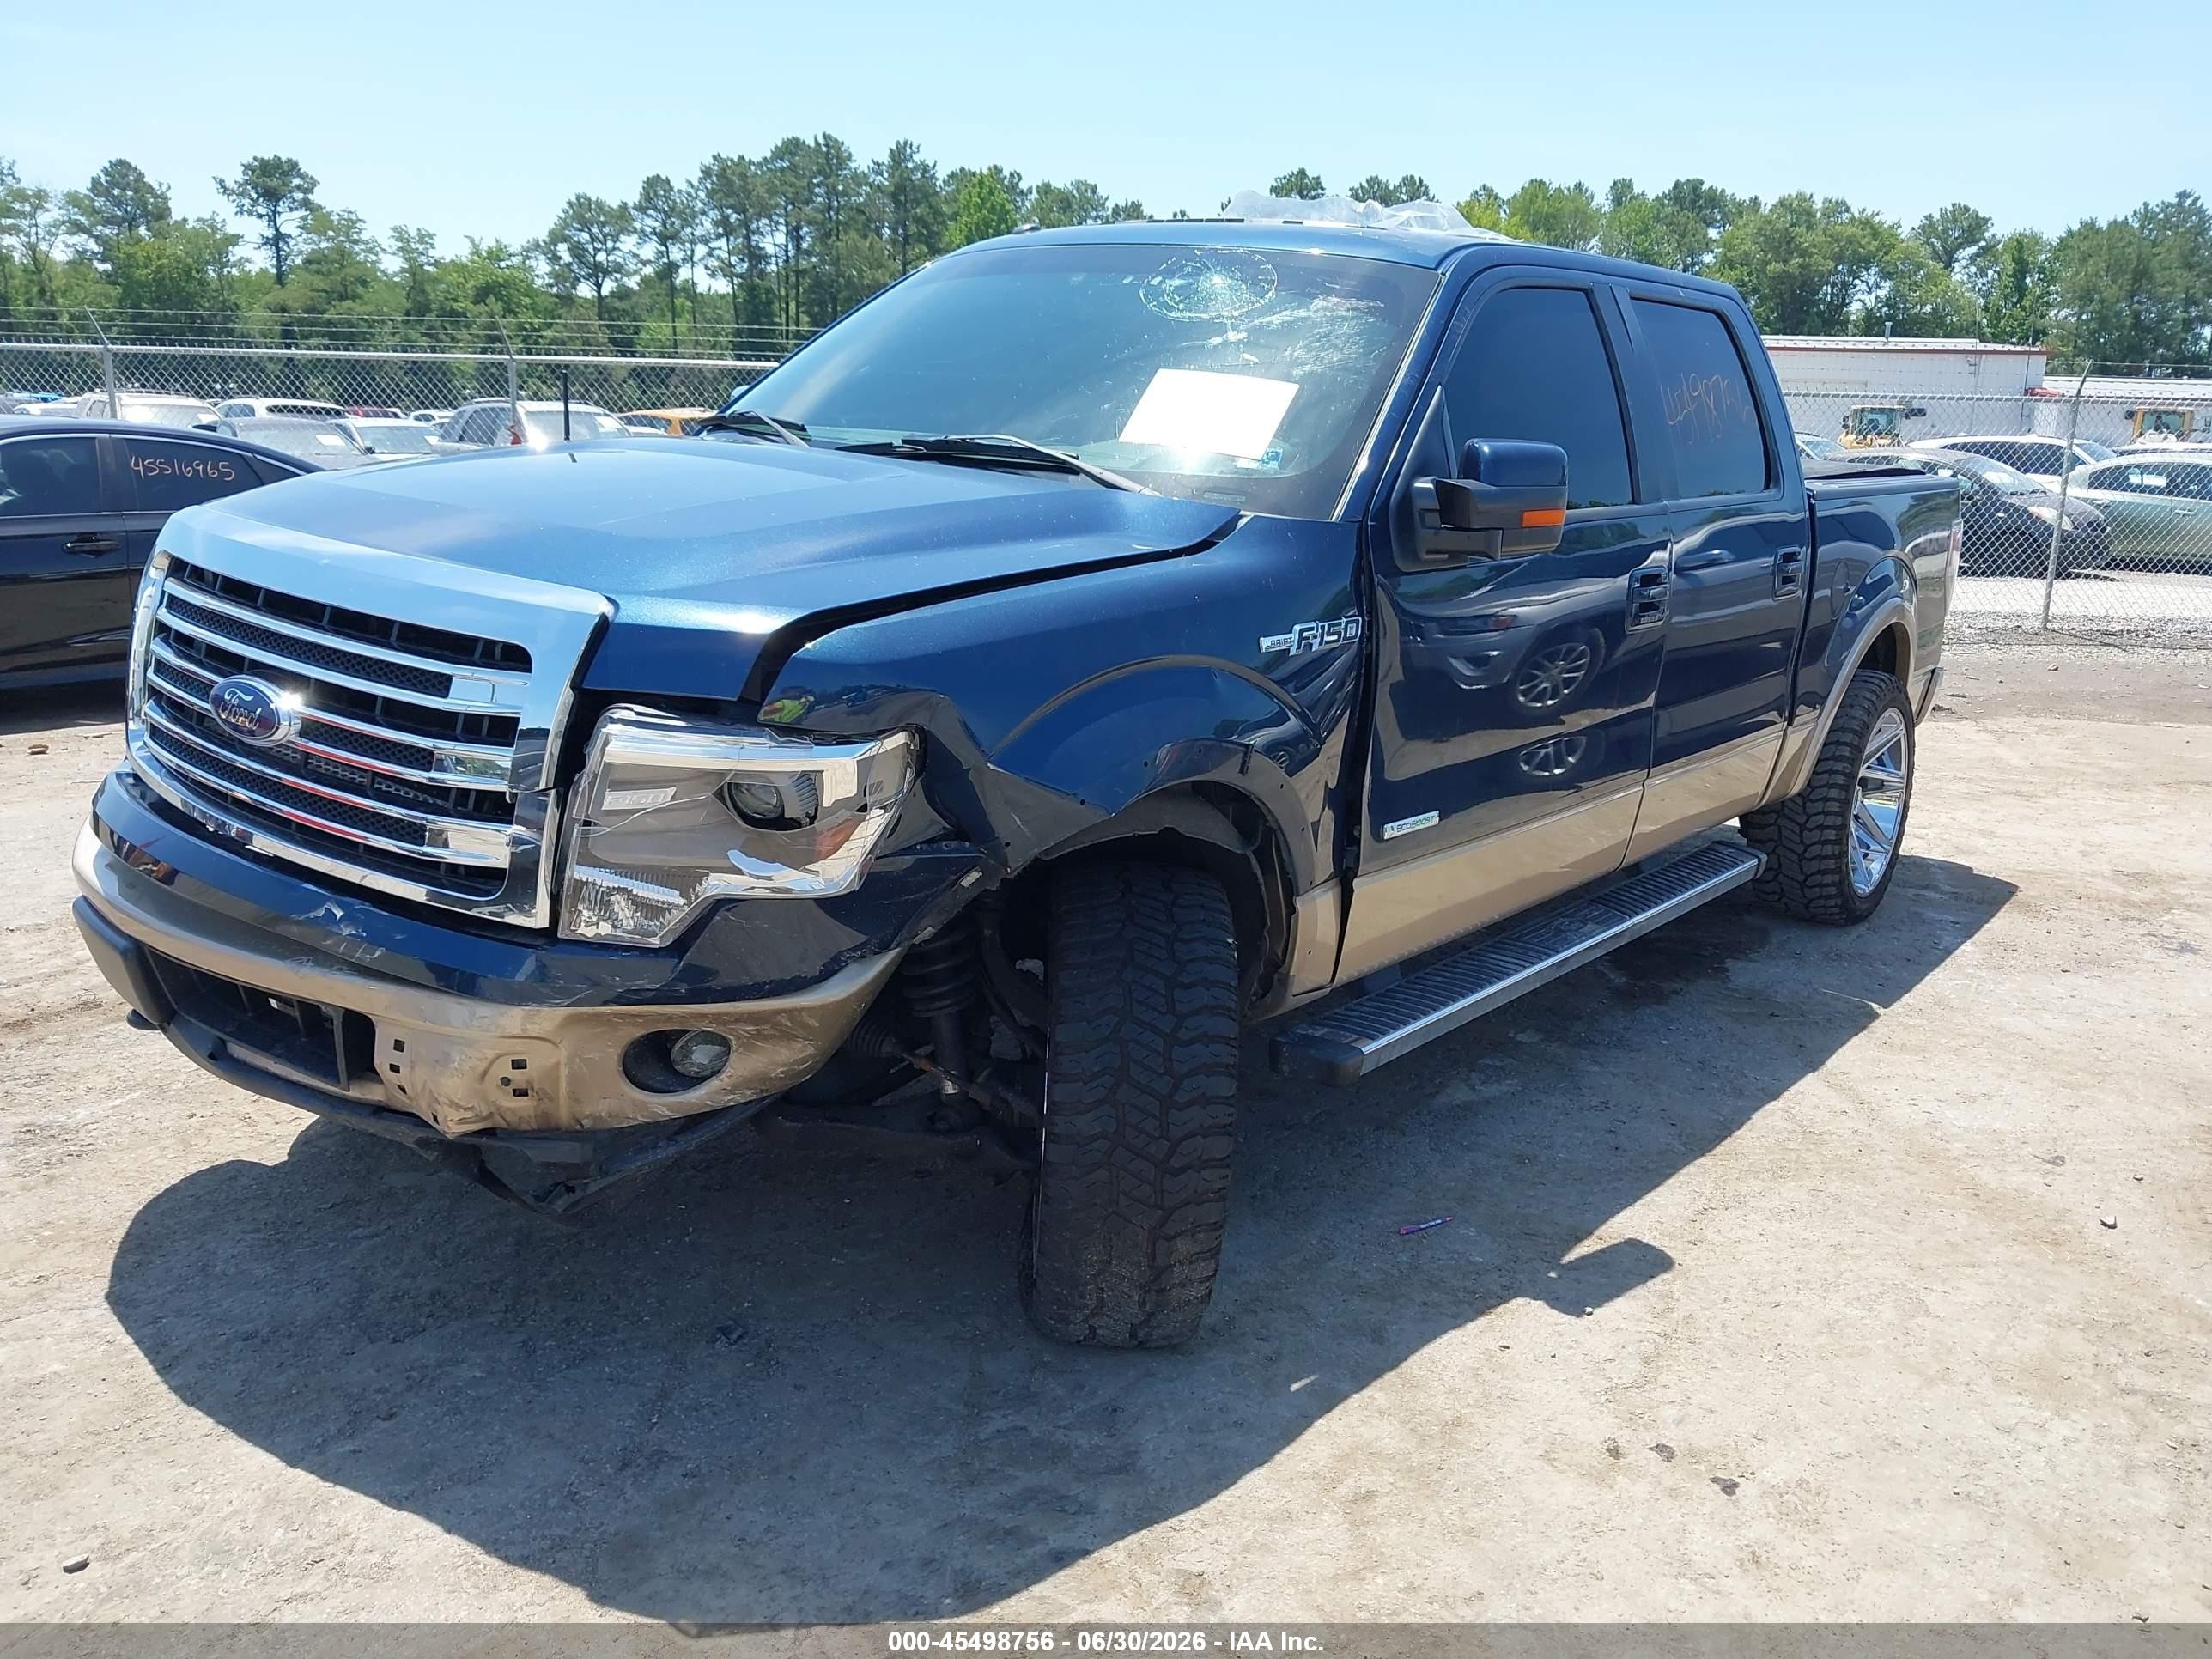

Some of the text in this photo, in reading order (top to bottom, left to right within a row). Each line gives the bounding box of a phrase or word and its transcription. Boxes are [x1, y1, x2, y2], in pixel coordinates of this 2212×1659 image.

[130, 455, 234, 482] 45516965
[218, 687, 263, 731] Ford
[1396, 815, 1436, 833] ECOBOOST
